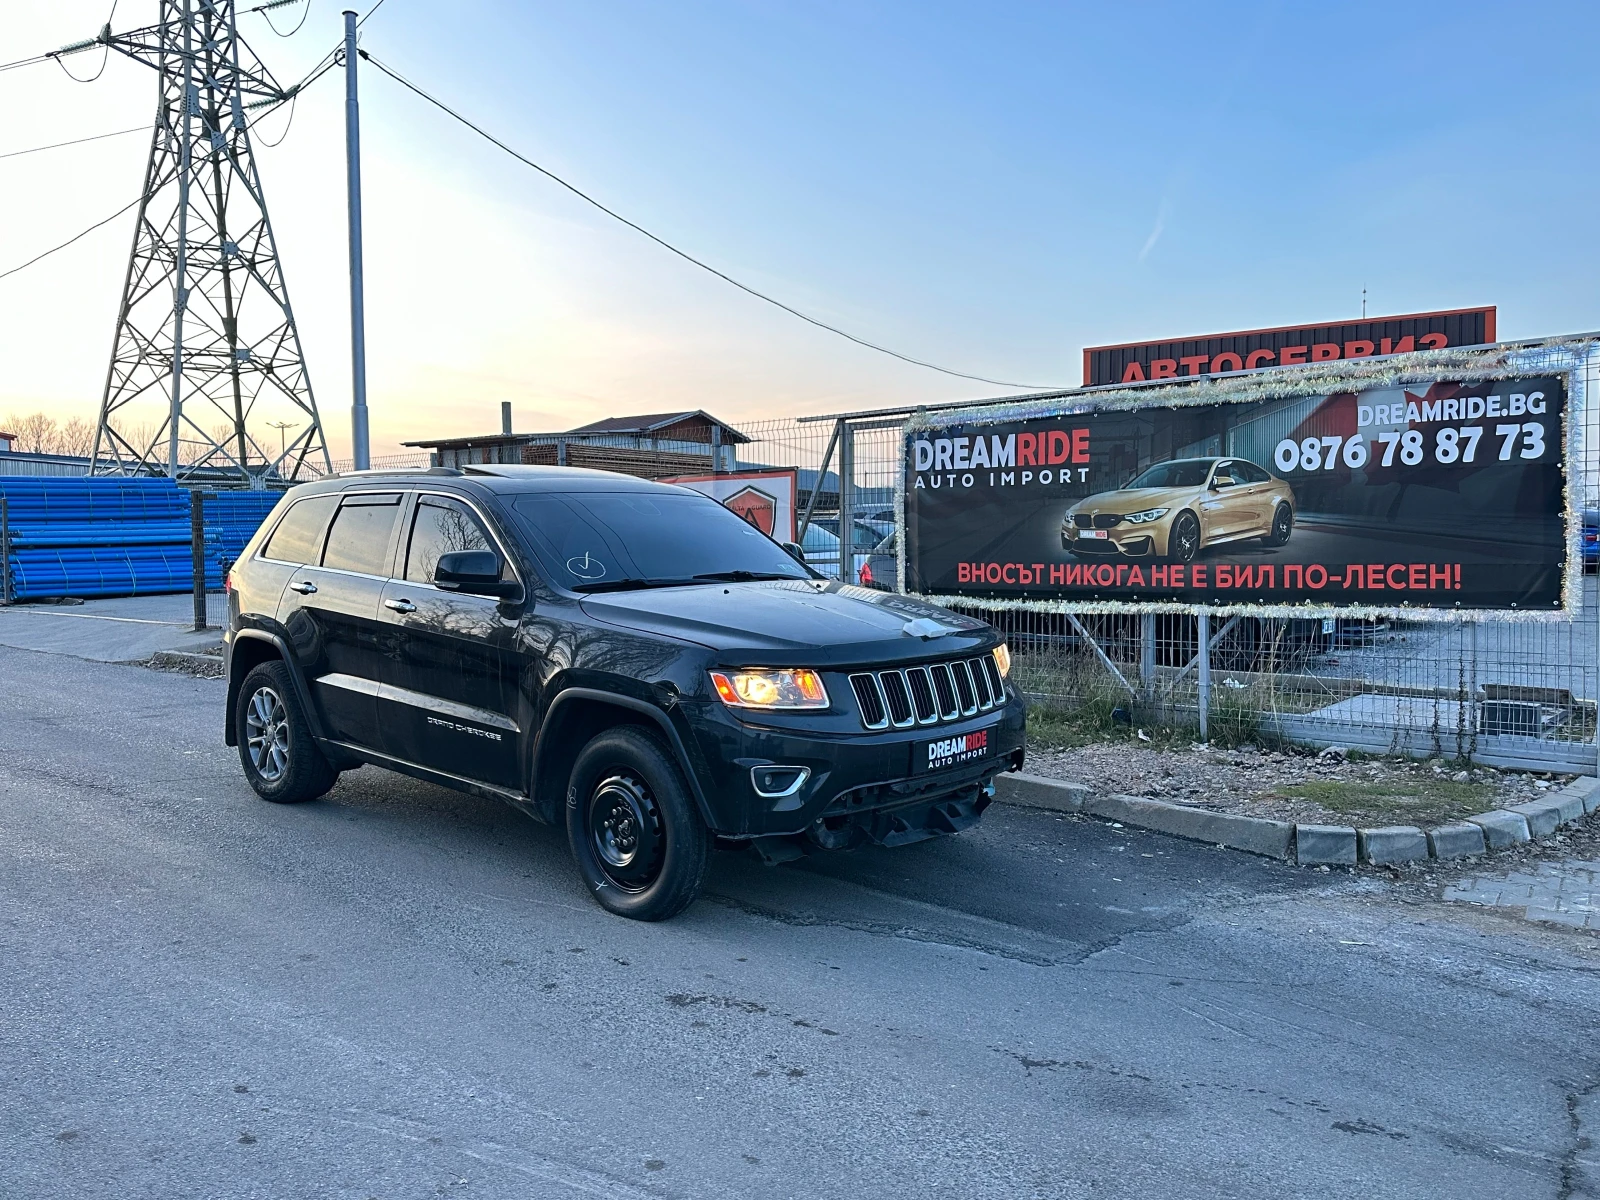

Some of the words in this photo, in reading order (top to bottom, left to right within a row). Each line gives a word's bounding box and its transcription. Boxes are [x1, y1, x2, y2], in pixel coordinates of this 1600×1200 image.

[1357, 391, 1546, 427] DREAMRIDE.BG
[914, 428, 1091, 472] DREAMRIDE
[1274, 433, 1367, 472] 0876
[1378, 429, 1424, 467] 78
[1435, 425, 1484, 464] 87
[1495, 422, 1546, 461] 73
[914, 472, 975, 489] AUTO
[989, 467, 1090, 487] IMPORT
[957, 562, 1045, 585] ВНОСЪТ
[1049, 563, 1146, 587] НИКОГА
[1151, 564, 1185, 588] НЕ
[1192, 564, 1208, 588] Е
[1215, 564, 1275, 589] БИЛ
[1283, 563, 1462, 590] ПО-ЛЕСЕН!
[427, 716, 455, 729] GRAND
[455, 724, 502, 741] CHEROKEE
[928, 730, 987, 760] DREAMRIDE
[928, 757, 953, 769] AUTO
[956, 746, 988, 763] IMPORT
